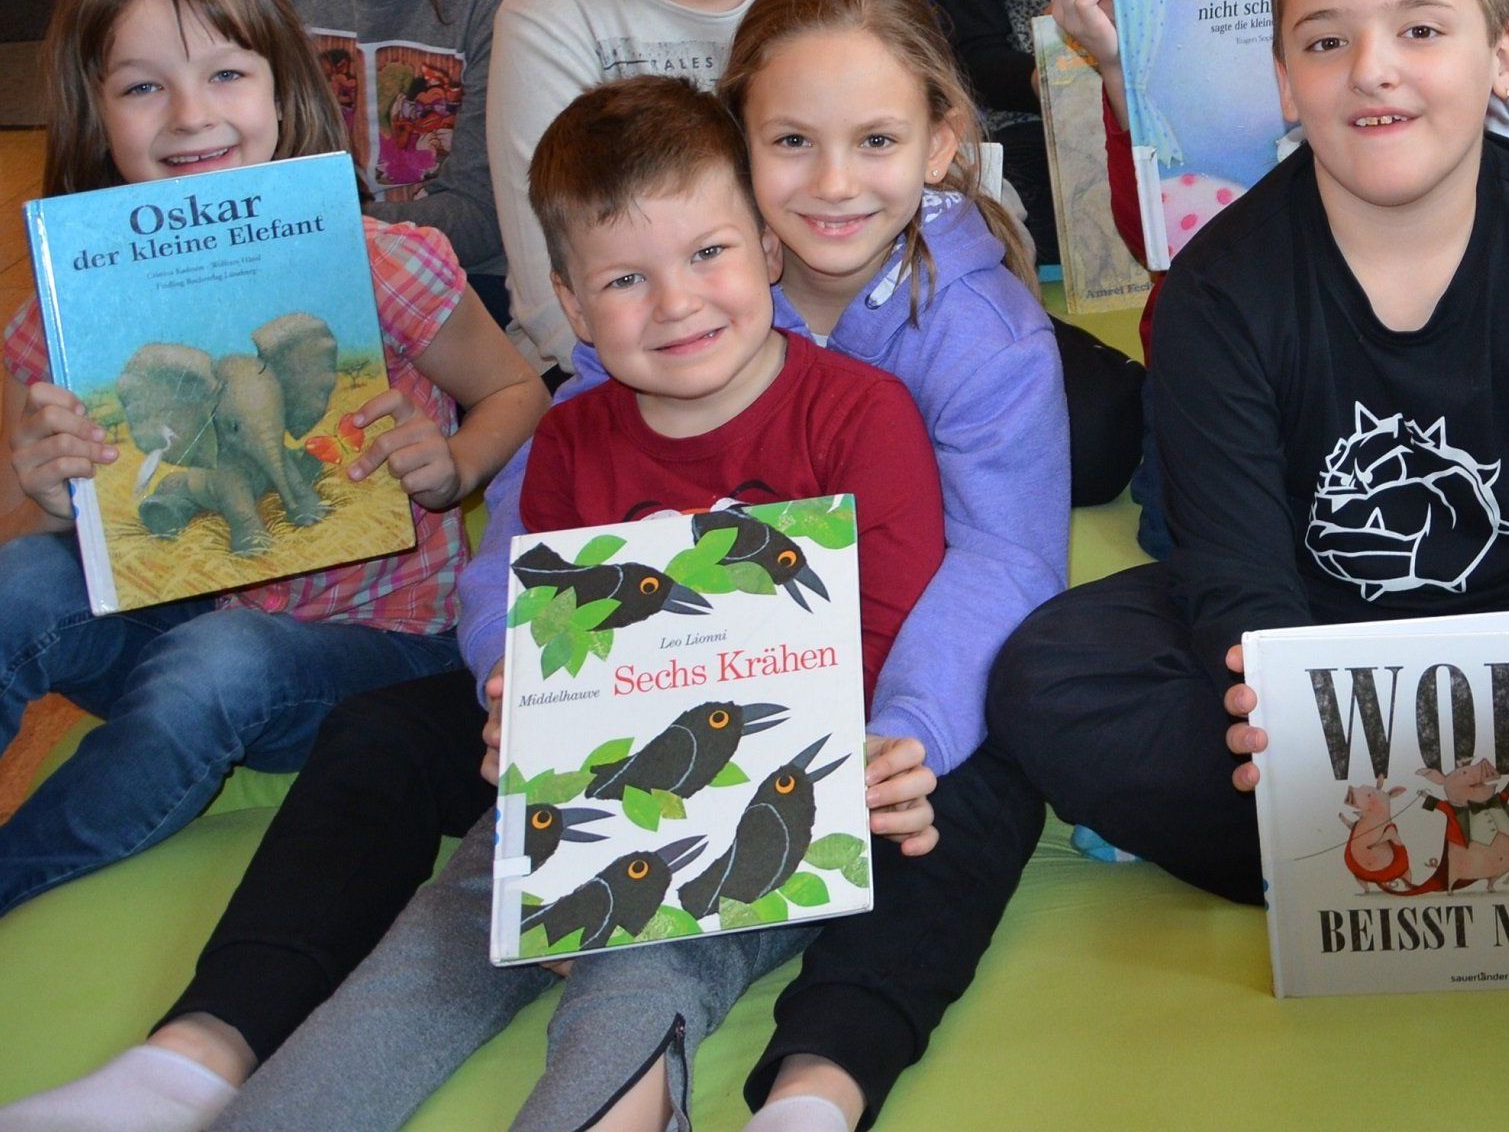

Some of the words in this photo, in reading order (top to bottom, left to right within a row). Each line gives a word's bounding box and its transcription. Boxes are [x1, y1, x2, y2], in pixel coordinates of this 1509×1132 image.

[1198, 0, 1238, 20] nicht
[1210, 24, 1233, 35] sagte
[1235, 20, 1248, 30] die
[650, 56, 714, 71] TALES
[130, 194, 262, 236] Oskar
[73, 249, 120, 271] der
[130, 234, 218, 262] kleine
[229, 215, 326, 247] Elefant
[660, 635, 682, 649] Leo
[686, 630, 727, 647] Lionni
[613, 659, 707, 698] Sechs
[717, 643, 839, 683] Krähen
[519, 687, 600, 708] Middelhauve
[1317, 905, 1474, 954] BEISST
